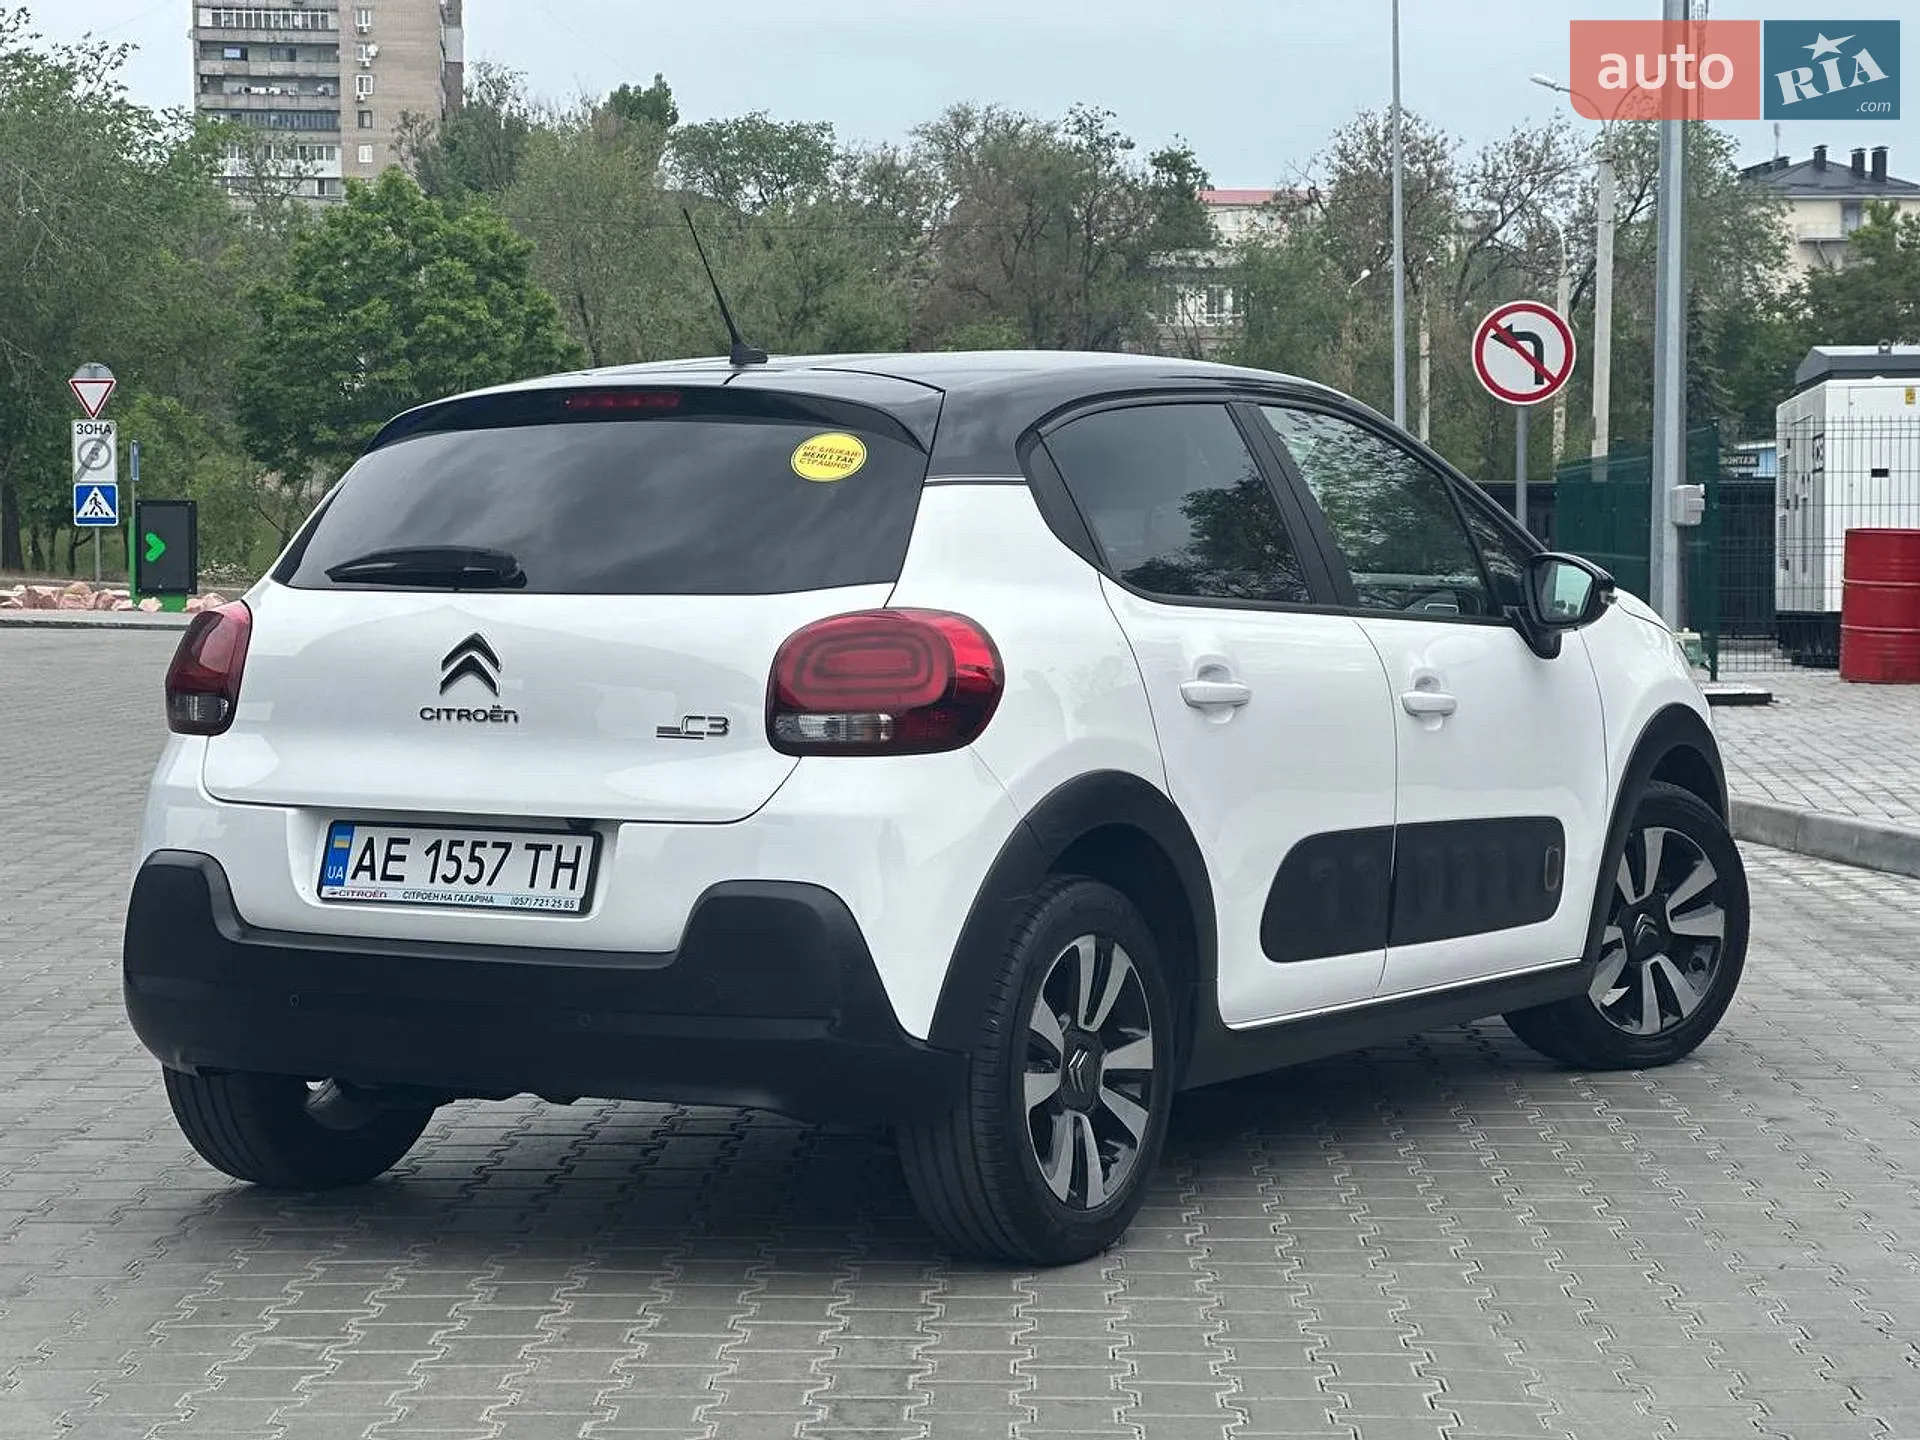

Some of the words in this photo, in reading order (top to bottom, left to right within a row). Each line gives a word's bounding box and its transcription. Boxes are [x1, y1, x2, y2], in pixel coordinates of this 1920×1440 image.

[76, 423, 112, 435] ЗОНА
[836, 455, 855, 464] ТАК
[672, 715, 729, 738] C3
[350, 836, 411, 882] AE
[424, 838, 512, 887] 1557
[524, 842, 582, 891] TH
[327, 865, 344, 880] UA
[533, 898, 549, 907] 721
[551, 899, 562, 908] 25
